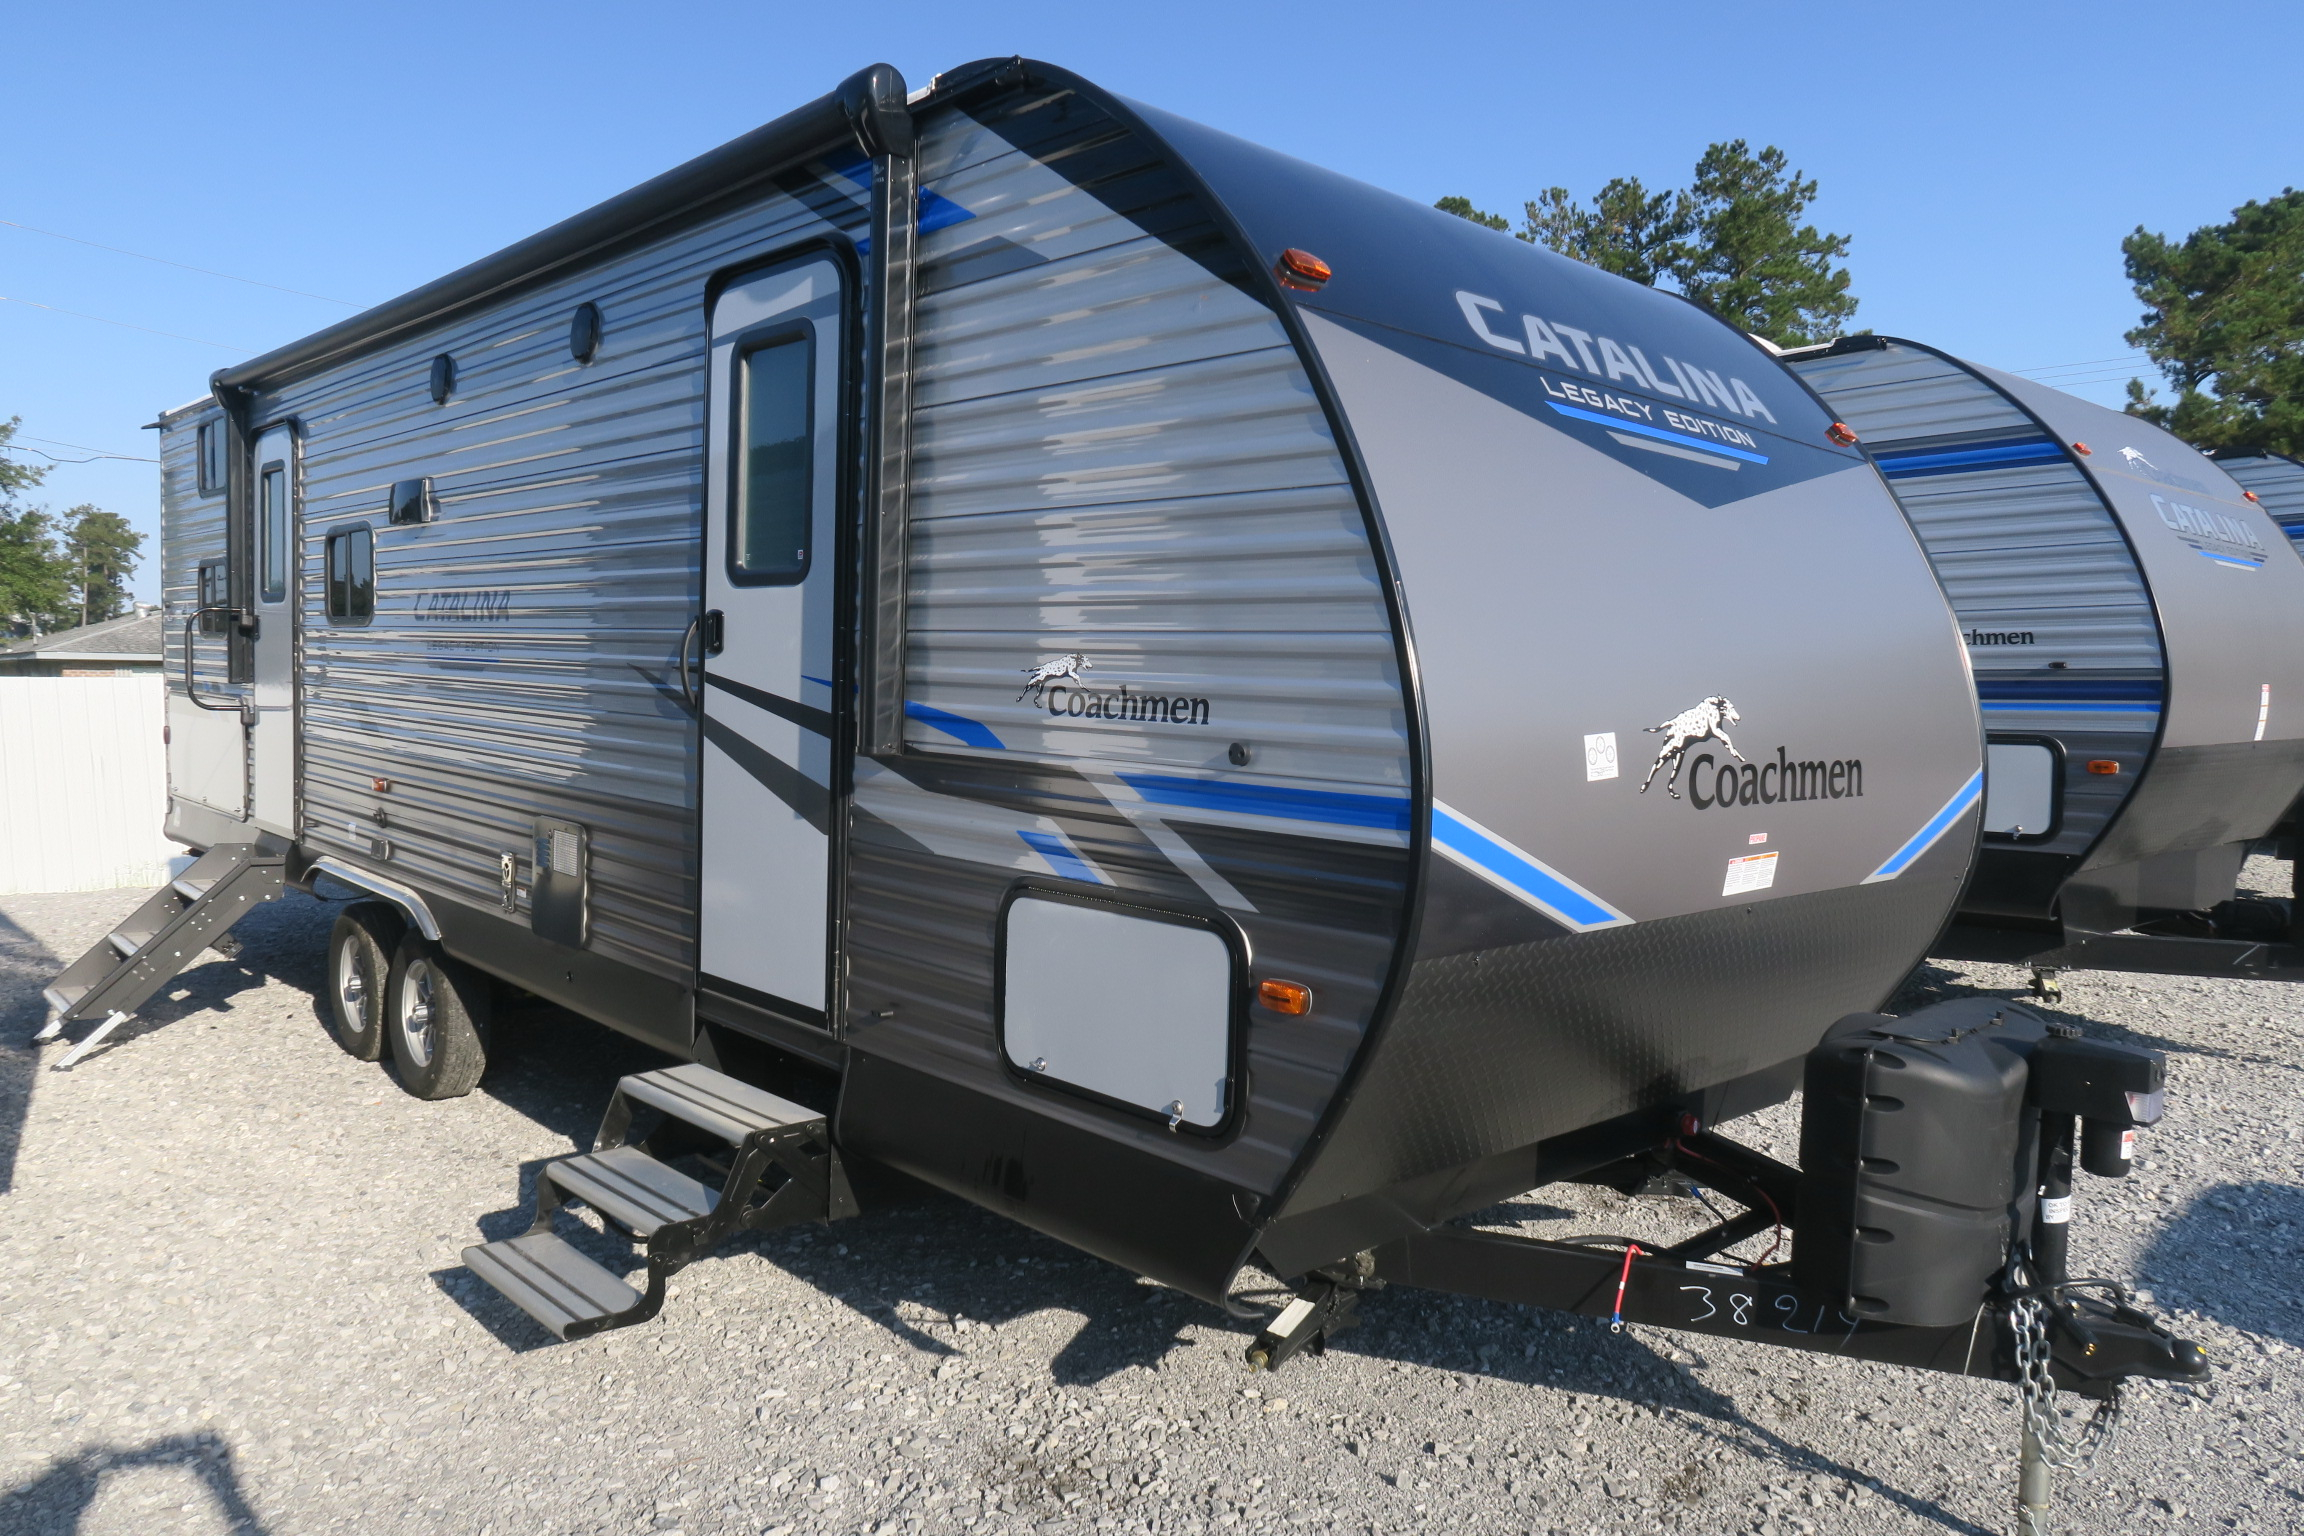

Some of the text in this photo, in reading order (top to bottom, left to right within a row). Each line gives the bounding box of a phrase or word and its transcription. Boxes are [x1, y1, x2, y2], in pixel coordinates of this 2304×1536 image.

[1455, 290, 1777, 425] CATALINA
[1539, 376, 1757, 449] LEGACY EDITION
[2149, 493, 2266, 551] CATALINA
[1963, 628, 2035, 646] chmen
[1048, 684, 1210, 726] Coachmen
[1688, 745, 1864, 811] Coachmen
